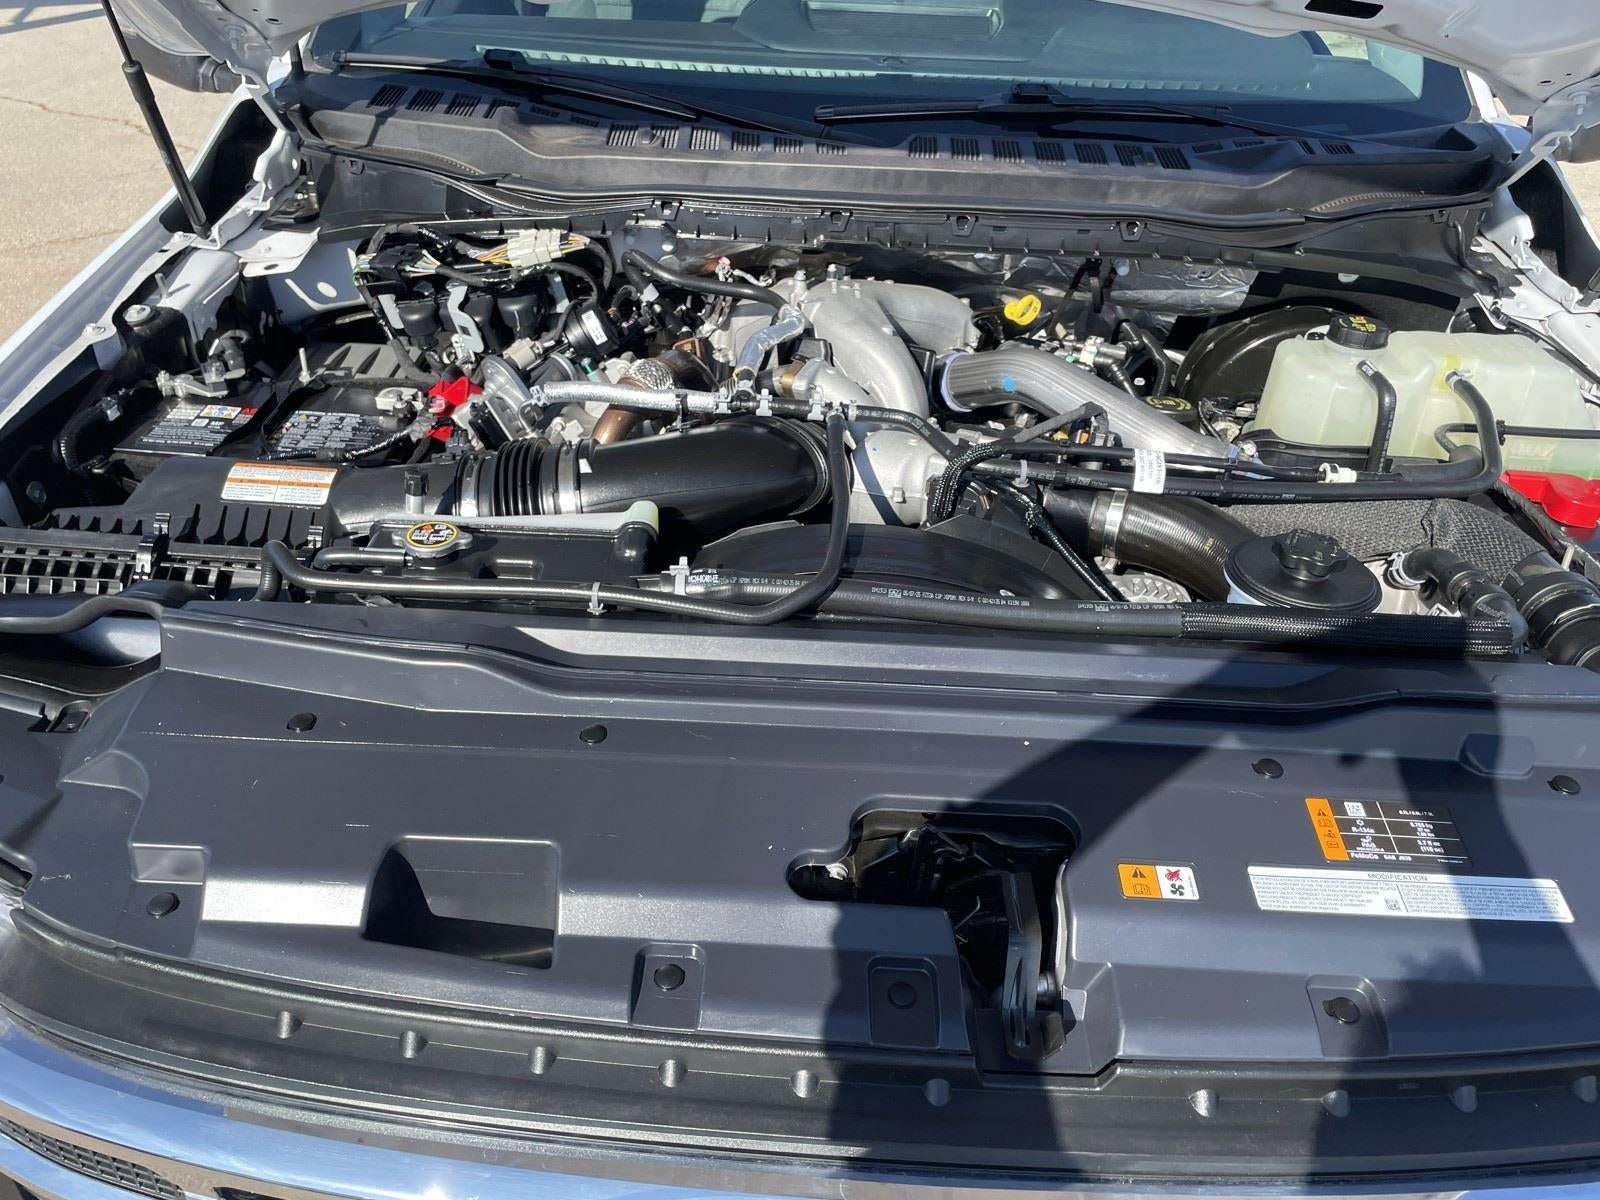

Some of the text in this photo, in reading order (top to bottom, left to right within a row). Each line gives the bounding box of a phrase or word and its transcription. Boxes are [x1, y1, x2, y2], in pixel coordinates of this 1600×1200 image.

[1351, 826, 1375, 834] R-134a
[1350, 852, 1379, 860] FoMoCo
[1367, 873, 1428, 881] MODIFICATION
